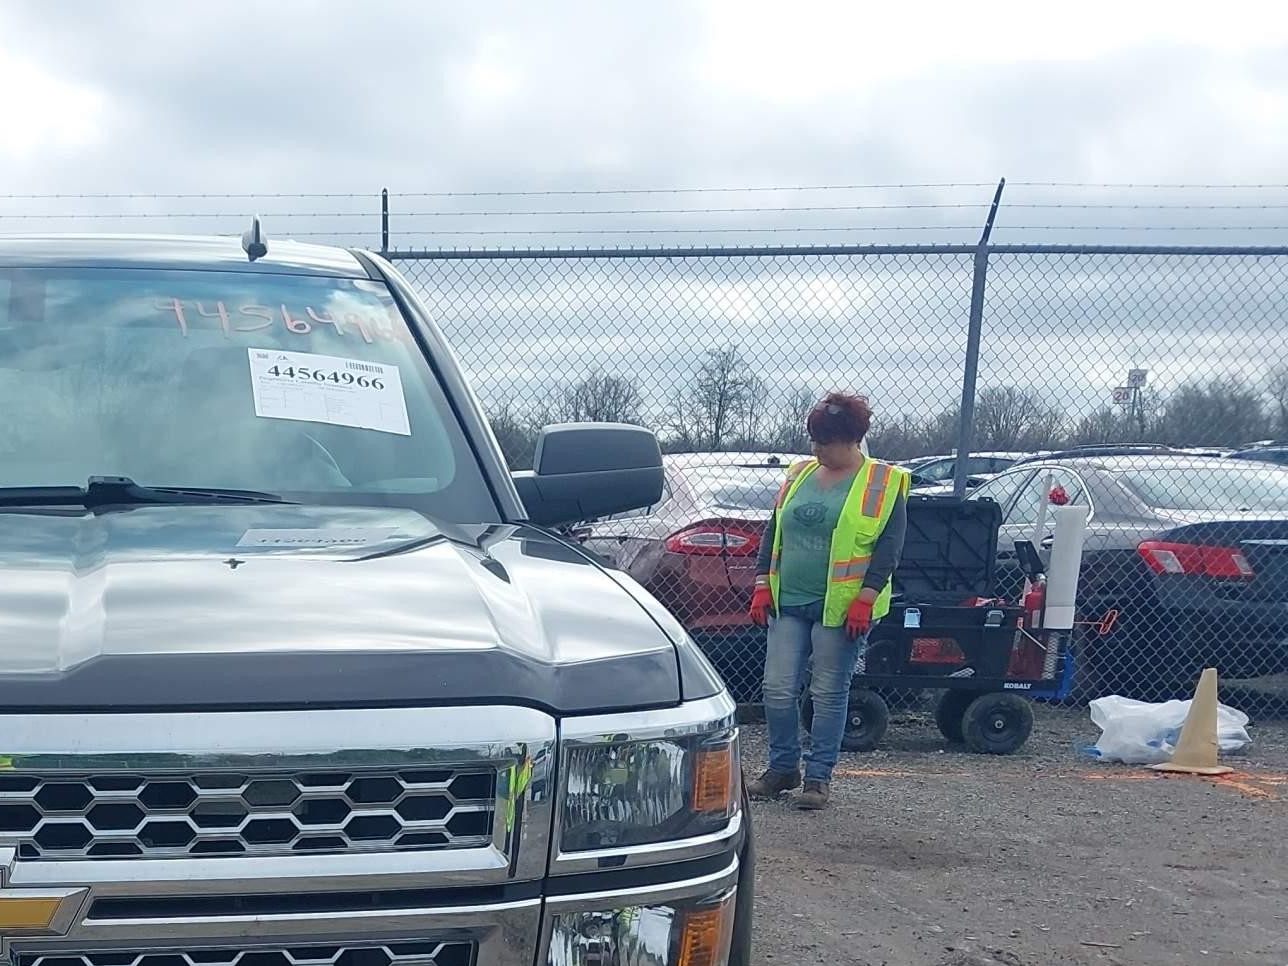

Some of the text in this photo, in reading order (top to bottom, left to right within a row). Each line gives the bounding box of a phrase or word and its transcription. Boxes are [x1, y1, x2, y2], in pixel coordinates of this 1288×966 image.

[154, 297, 408, 345] 445649
[267, 365, 385, 391] 44564966
[1113, 391, 1129, 401] 20
[1003, 682, 1032, 690] KOBALT
